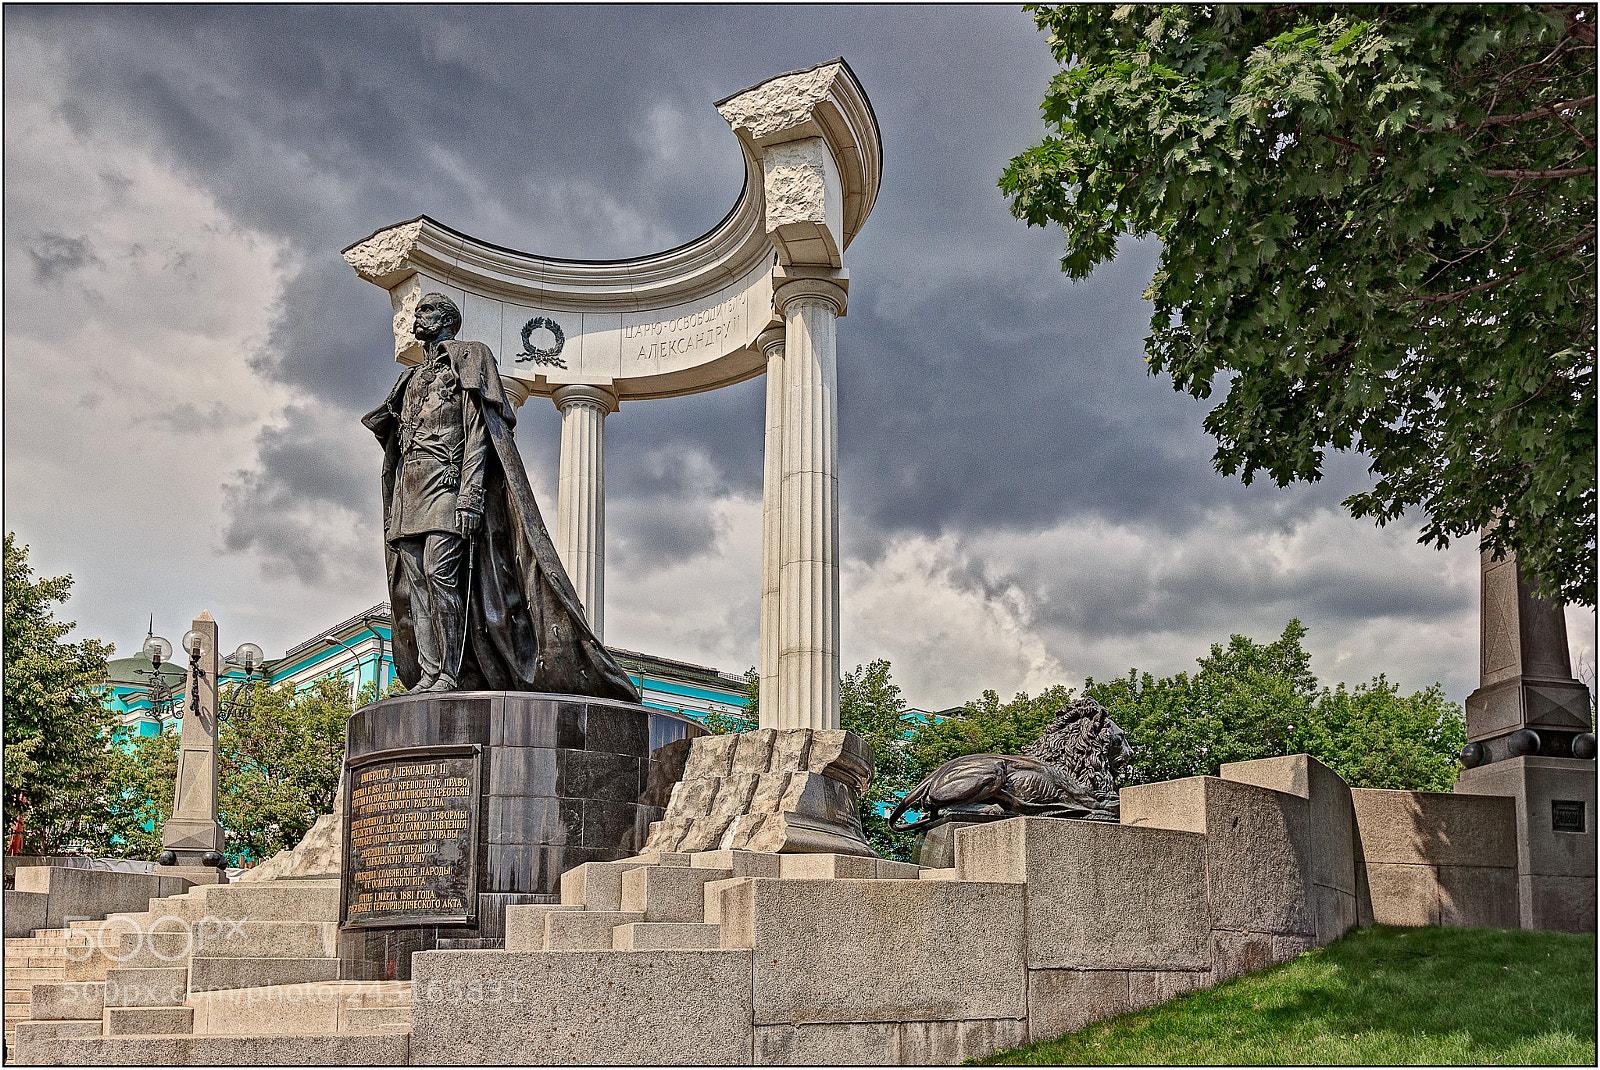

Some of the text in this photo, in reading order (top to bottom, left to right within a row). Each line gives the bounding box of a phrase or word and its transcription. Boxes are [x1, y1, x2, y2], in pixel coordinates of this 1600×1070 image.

[392, 764, 436, 778] АЛЕКСАНДР
[398, 778, 441, 791] КРЕПОСТНОЕ
[444, 777, 468, 787] ПРАВО
[396, 788, 431, 800] МИЛЛИОНЫ
[433, 787, 470, 797] КРЕСТЬЯН
[414, 797, 445, 808] РАБСТВА
[393, 812, 428, 824] СУДЕБНУЮ
[431, 810, 467, 820] РЕФОРМЫ
[405, 820, 468, 831] САМОУПРАВЛЕНИЯ
[398, 830, 427, 841] ЗЕМСКИЕ
[429, 828, 459, 840] УПРАВЫ
[387, 843, 437, 855] МНОГОЛЕТНЮЮ
[404, 853, 427, 863] ВОЙНУ
[420, 866, 452, 877] НАРОДЫ
[371, 877, 410, 888] ОСМАНСКОГО
[412, 876, 427, 886] ИГА
[400, 890, 414, 900] 1881
[416, 890, 436, 900] ГОДА
[373, 899, 441, 911] ТЕРРОРИСТИЧЕСКОГО
[442, 898, 463, 908] АКТА
